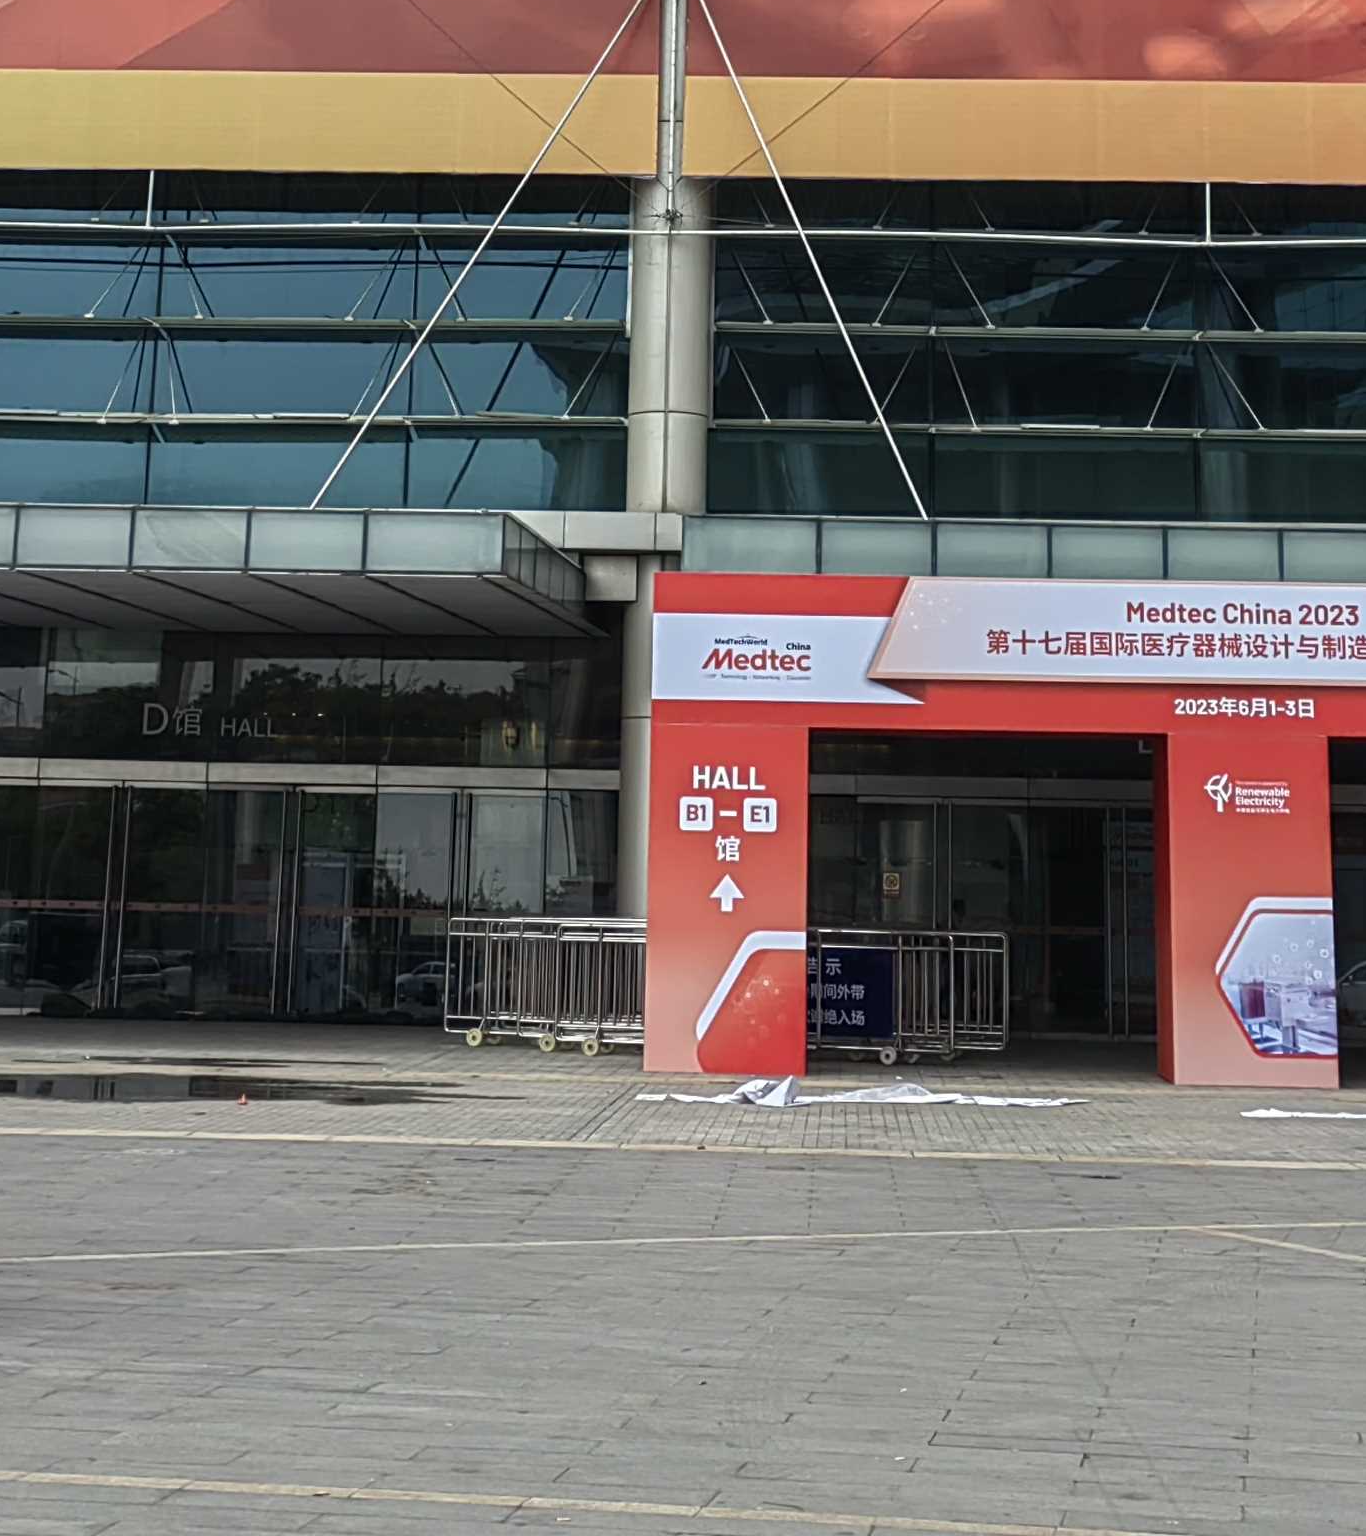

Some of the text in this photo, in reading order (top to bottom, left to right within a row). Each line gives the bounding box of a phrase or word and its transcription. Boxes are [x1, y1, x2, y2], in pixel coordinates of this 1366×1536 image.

[1127, 602, 1360, 626] Medtec China 2023
[786, 642, 811, 651] China
[701, 648, 812, 672] Medtec
[1174, 697, 1316, 719] 2023年6月1-3日
[142, 702, 277, 738] D馆 HALL
[693, 765, 766, 790] HALL
[1235, 787, 1290, 797] Renewable
[1235, 797, 1285, 808] Electricity
[686, 804, 707, 822] B1
[750, 805, 770, 823] E1
[716, 835, 741, 862] 馆
